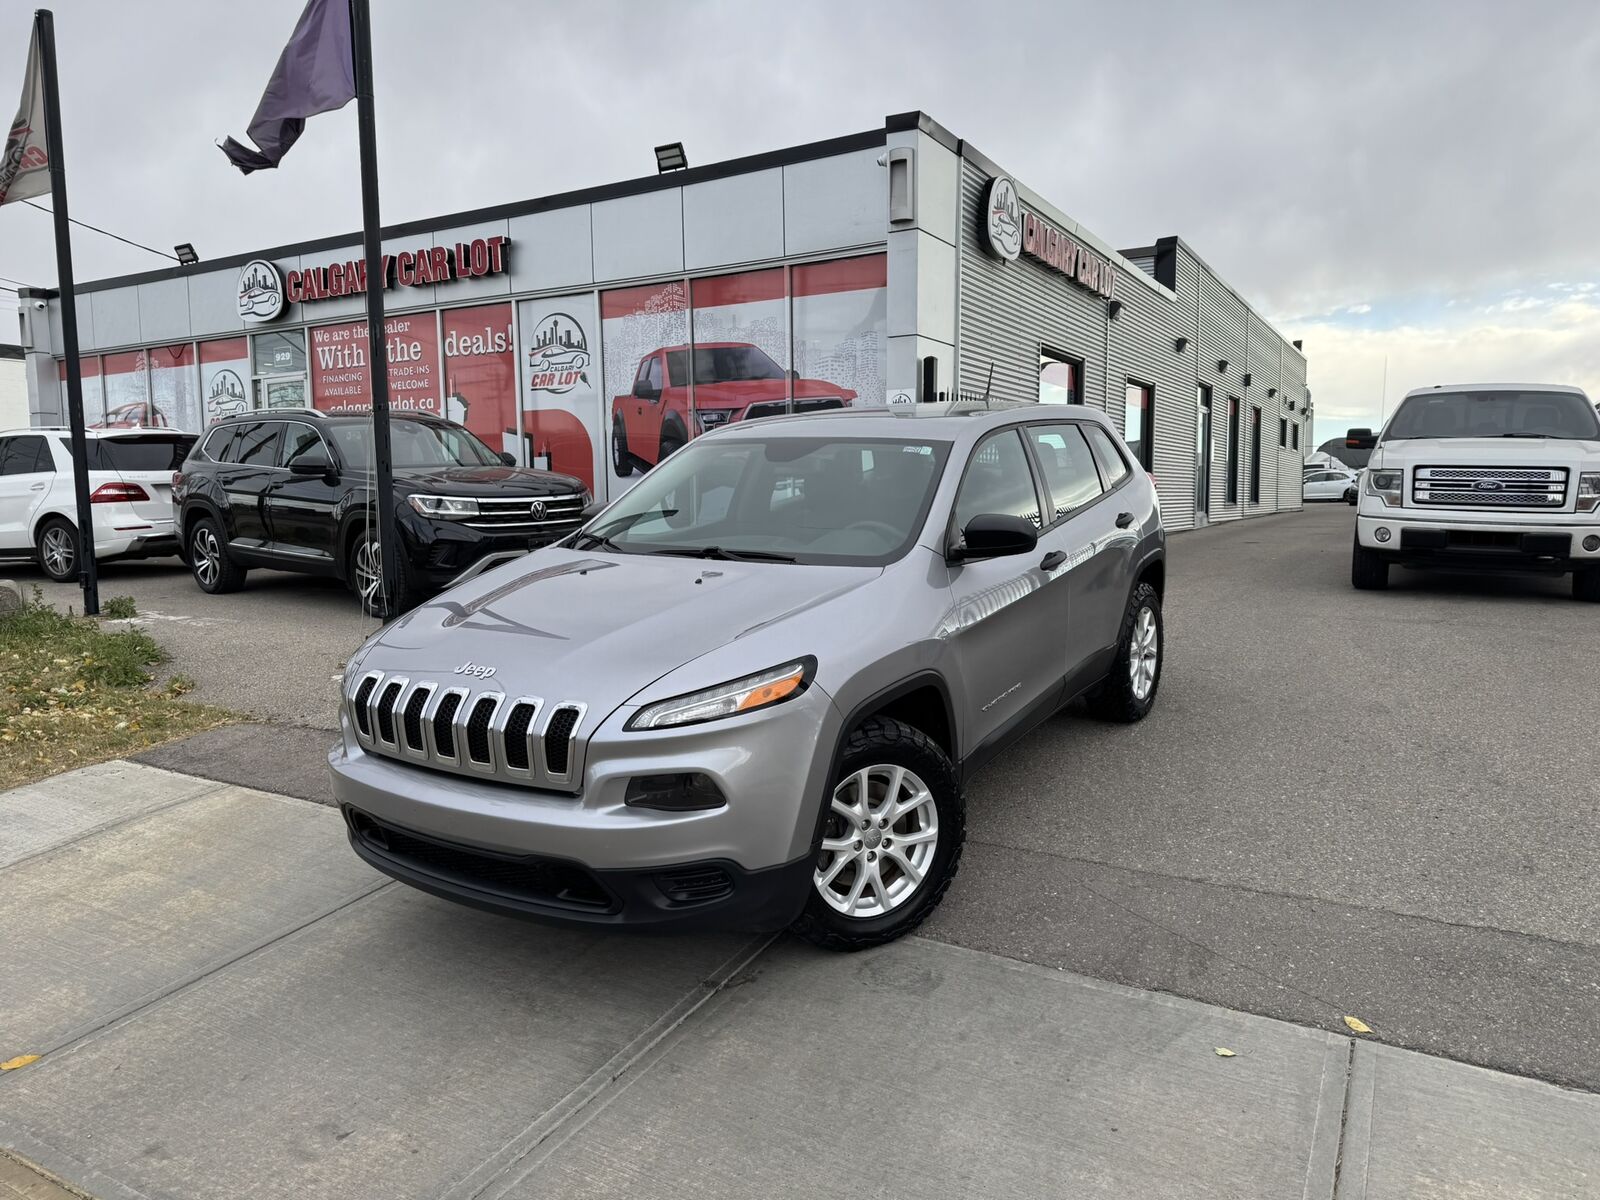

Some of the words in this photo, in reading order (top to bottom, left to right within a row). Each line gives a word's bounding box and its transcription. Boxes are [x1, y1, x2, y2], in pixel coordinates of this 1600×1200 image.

[396, 246, 450, 287] CAR
[455, 236, 505, 277] LOT
[1024, 213, 1077, 277] CALGARY
[1077, 248, 1099, 291] CAR
[1099, 260, 1117, 300] LOT
[314, 330, 330, 343] We
[332, 331, 349, 341] are
[352, 326, 369, 339] the
[384, 320, 410, 334] aler
[317, 343, 366, 370] With
[386, 337, 422, 363] the
[445, 323, 514, 357] deals!
[275, 352, 291, 362] 929
[322, 372, 363, 384] FINANCING
[389, 364, 431, 376] TRADE-INS
[390, 378, 429, 391] WELCOME
[531, 373, 555, 387] CAR
[558, 371, 581, 385] LOT
[324, 385, 362, 397] AVAILABLE
[454, 661, 497, 680] Jeep
